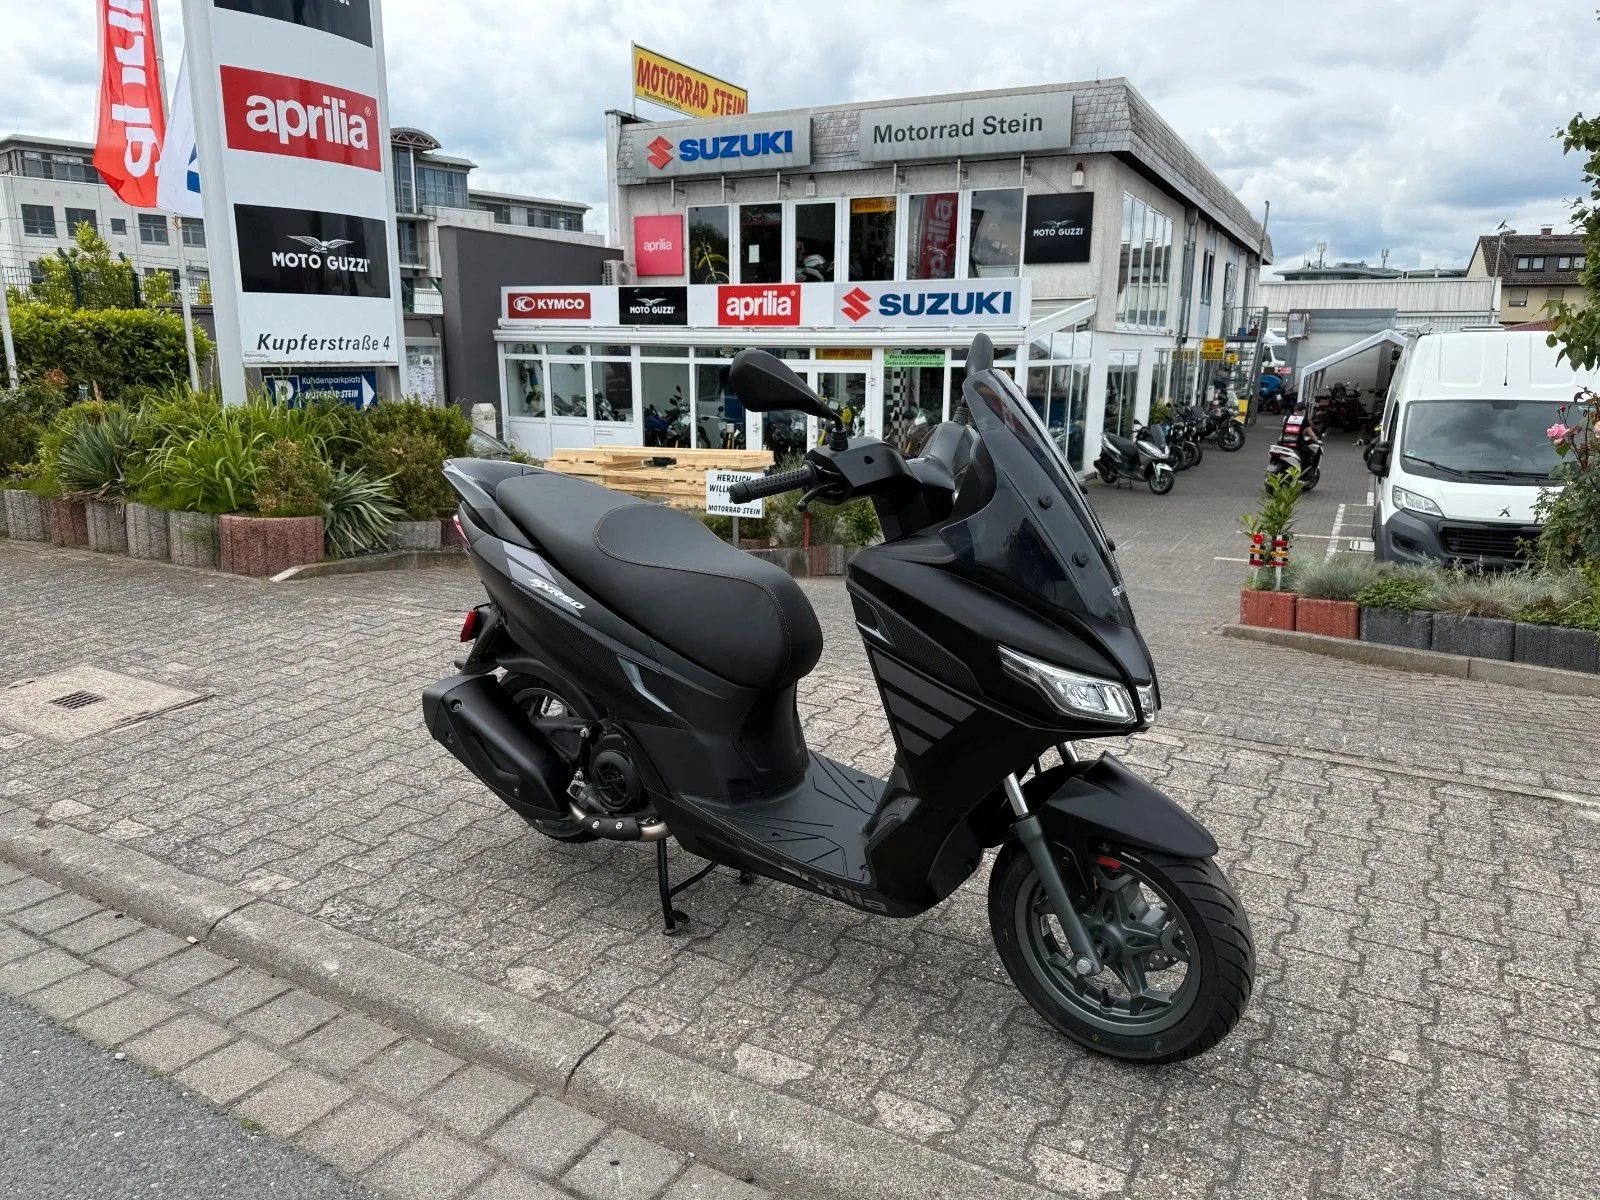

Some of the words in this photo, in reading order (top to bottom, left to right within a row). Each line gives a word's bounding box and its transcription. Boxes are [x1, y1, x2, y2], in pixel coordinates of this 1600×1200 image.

[637, 57, 709, 110] MOTORRAD
[712, 88, 745, 116] STEIN
[246, 94, 369, 150] aprilia
[873, 117, 974, 144] Motorrad
[982, 113, 1043, 136] Stein
[679, 130, 793, 162] SUZUKI
[1033, 228, 1056, 237] MOTO
[1058, 227, 1084, 236] GUZZI
[643, 238, 673, 253] aprilia
[271, 251, 322, 269] MOTO
[327, 255, 369, 273] GUZZI
[537, 298, 585, 310] KYMCO
[629, 306, 650, 314] MOTO
[652, 306, 674, 314] GUZZI
[726, 290, 792, 321] aprilia
[878, 291, 1012, 316] SUZUKI
[257, 333, 379, 355] Kupferstraße
[383, 335, 390, 350] 4
[341, 389, 359, 399] STEIN
[716, 473, 752, 483] HERZLICH
[708, 504, 742, 514] MOTORRAD
[742, 507, 761, 515] STEIN
